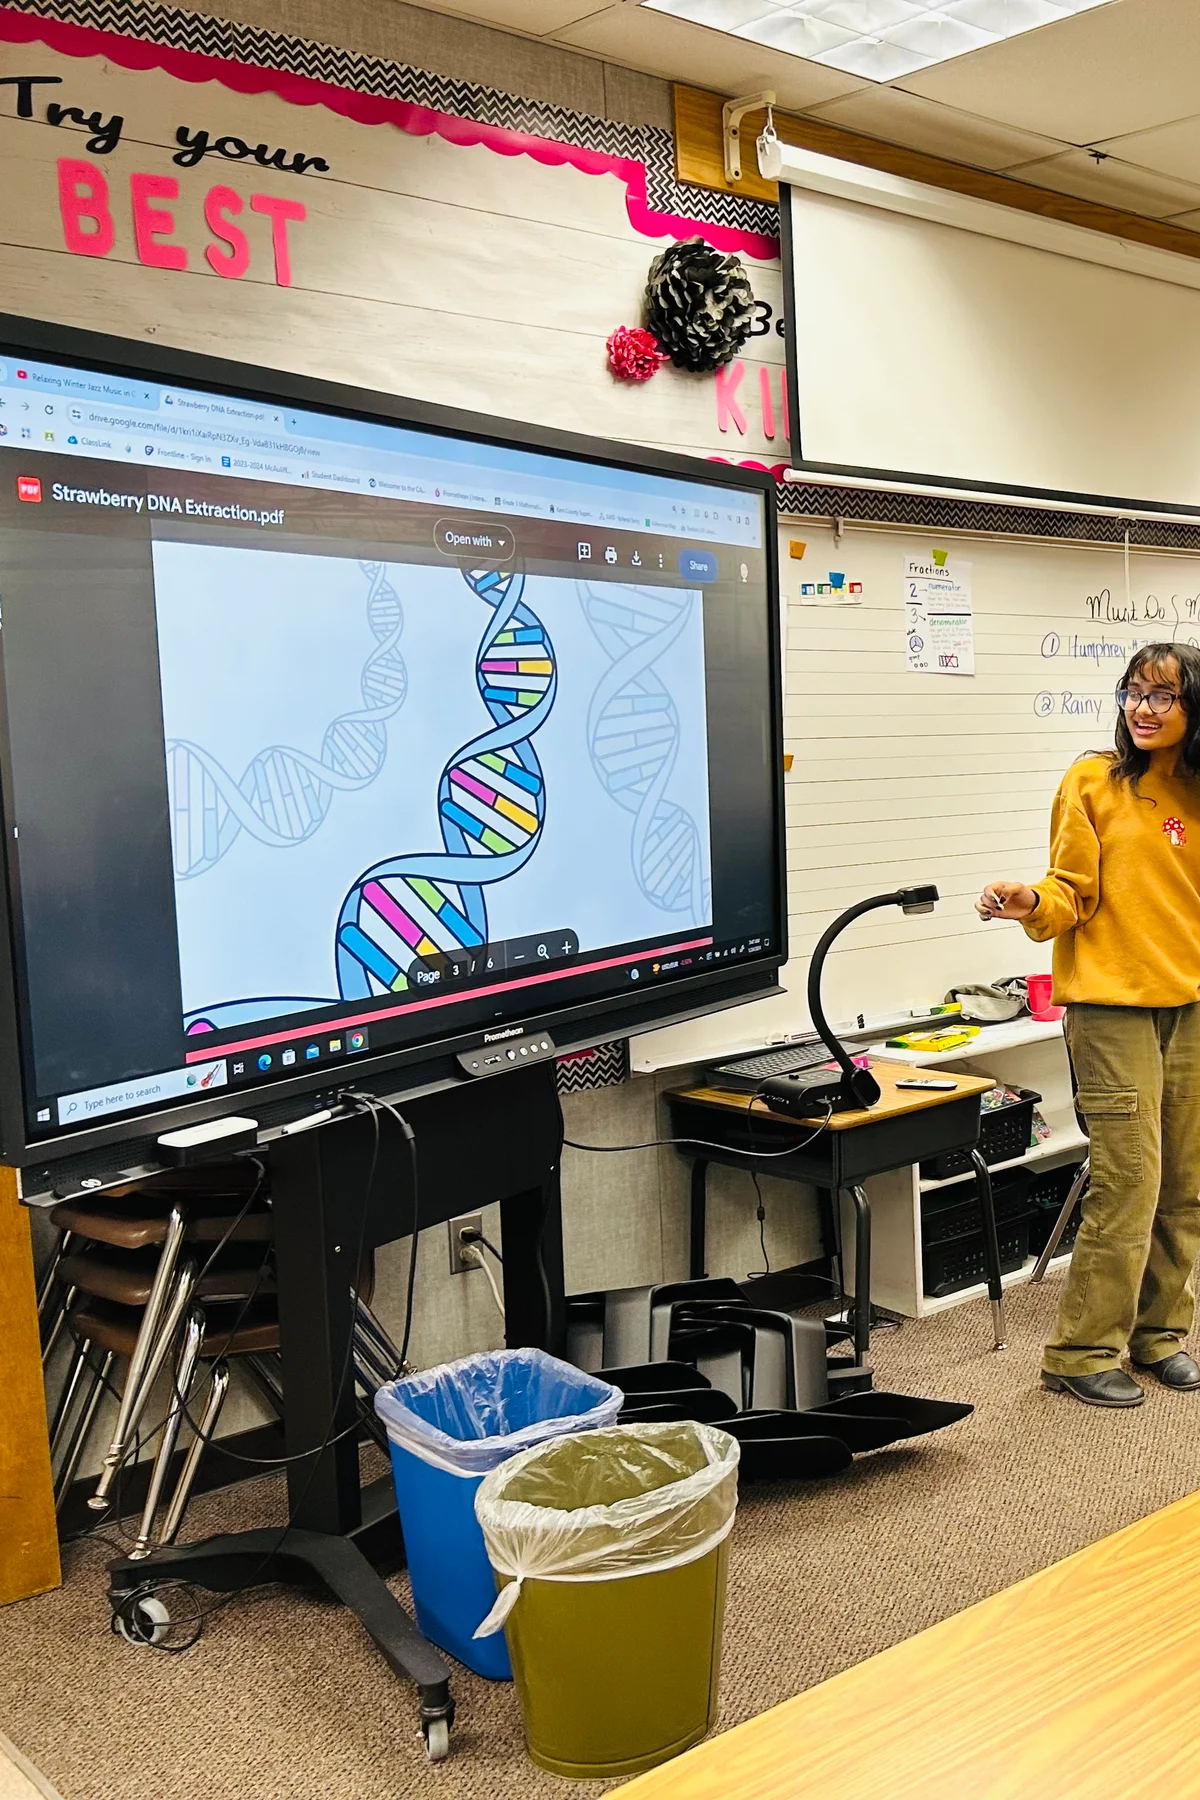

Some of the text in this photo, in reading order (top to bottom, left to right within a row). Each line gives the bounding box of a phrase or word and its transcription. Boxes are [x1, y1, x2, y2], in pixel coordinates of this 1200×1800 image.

[0, 76, 330, 174] Try your
[58, 157, 307, 287] BEST
[32, 373, 62, 387] Relaxing
[63, 378, 87, 390] Winter
[88, 382, 102, 392] Jazz
[102, 385, 122, 396] Music
[177, 399, 210, 412] Strawberry
[210, 404, 225, 413] DNA
[81, 437, 112, 449] ClassLink
[157, 447, 185, 459] Frontline
[190, 453, 204, 463] Sign
[20, 484, 39, 495] PDF
[52, 483, 285, 525] Strawberry DNA Extraction.pdf
[445, 531, 492, 547] Open with
[689, 561, 708, 572] Share
[909, 562, 950, 577] Fractions
[909, 583, 961, 598] 2 numerator
[1085, 588, 1166, 623] Must Do
[910, 607, 968, 626] 3 denominator
[1060, 690, 1104, 721] Rainy
[417, 968, 440, 985] Page
[452, 964, 460, 976] 3
[487, 957, 494, 969] 6
[484, 1027, 524, 1044] Promethean
[83, 1084, 161, 1112] Type here to search
